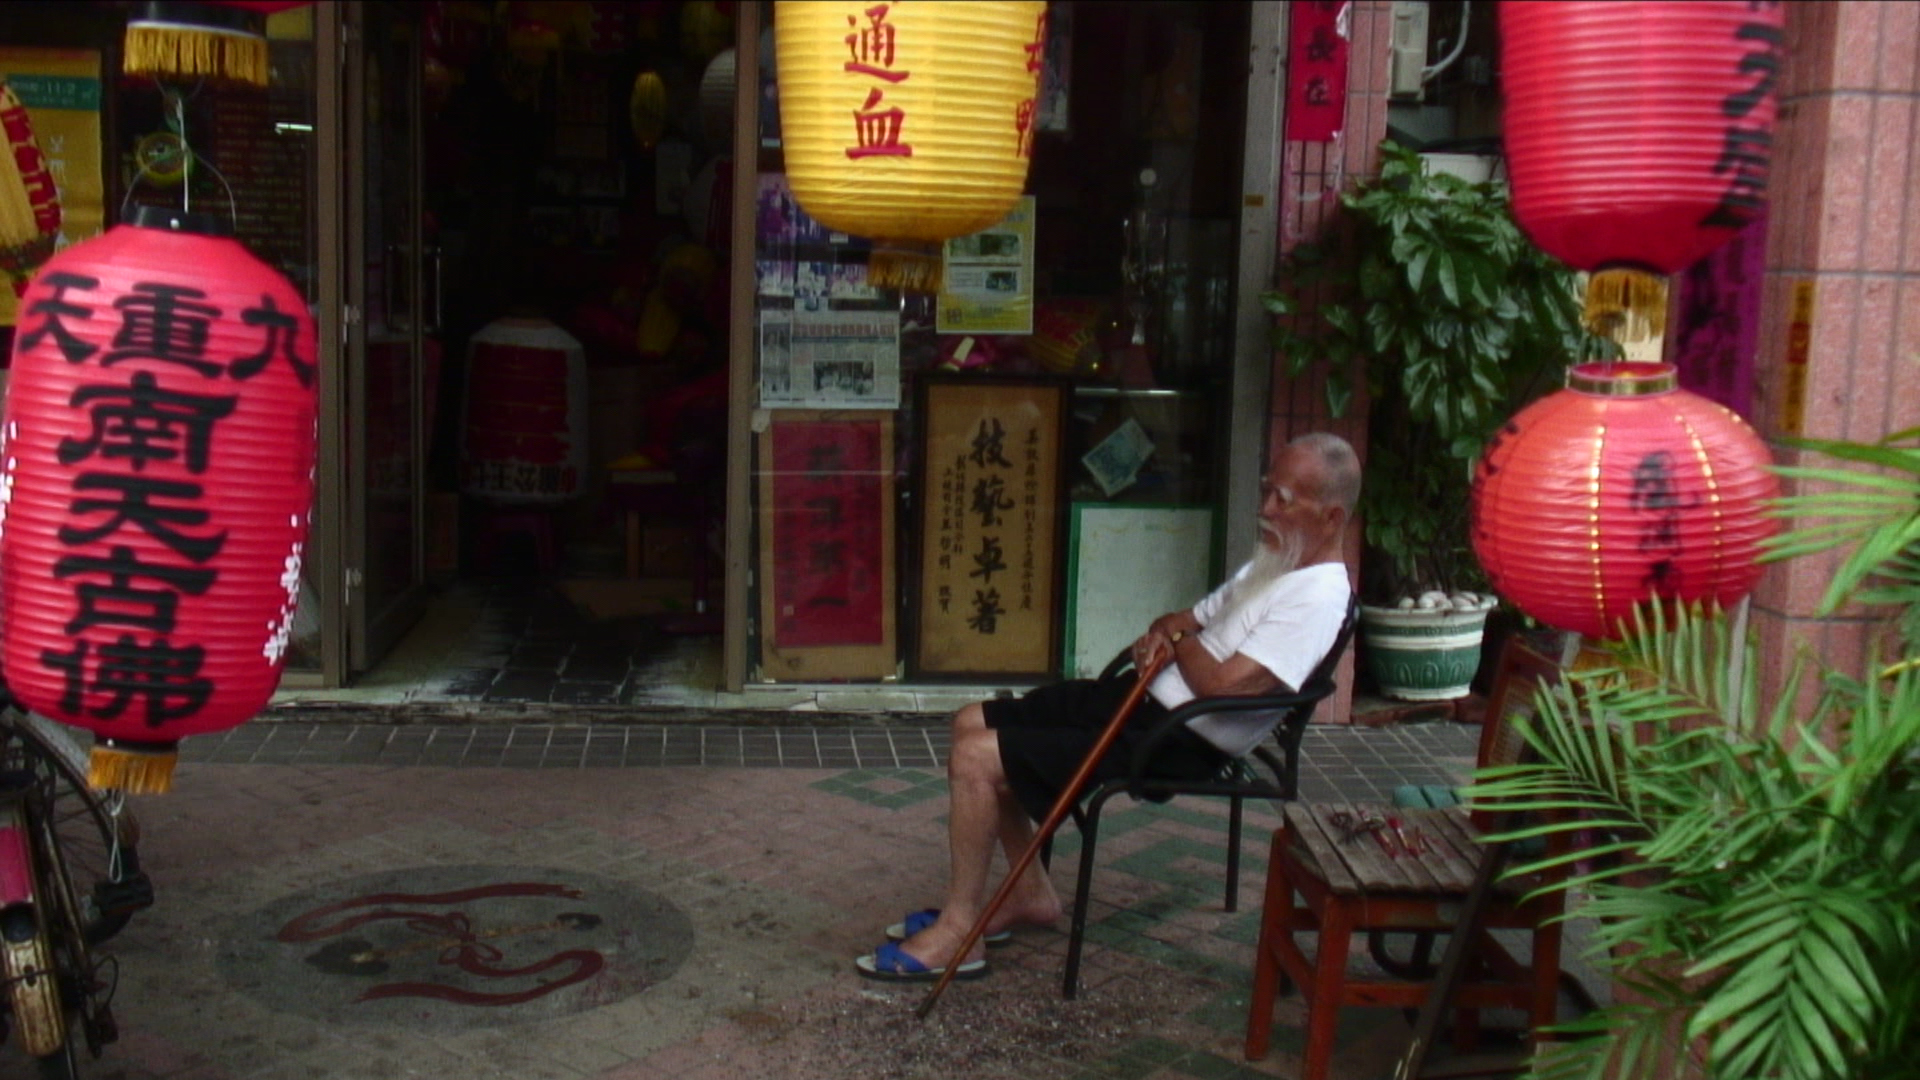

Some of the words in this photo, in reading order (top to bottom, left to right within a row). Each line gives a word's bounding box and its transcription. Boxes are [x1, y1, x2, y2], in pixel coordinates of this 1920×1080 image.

[843, 3, 912, 160] 通血
[966, 417, 1014, 635] 技藝卓著
